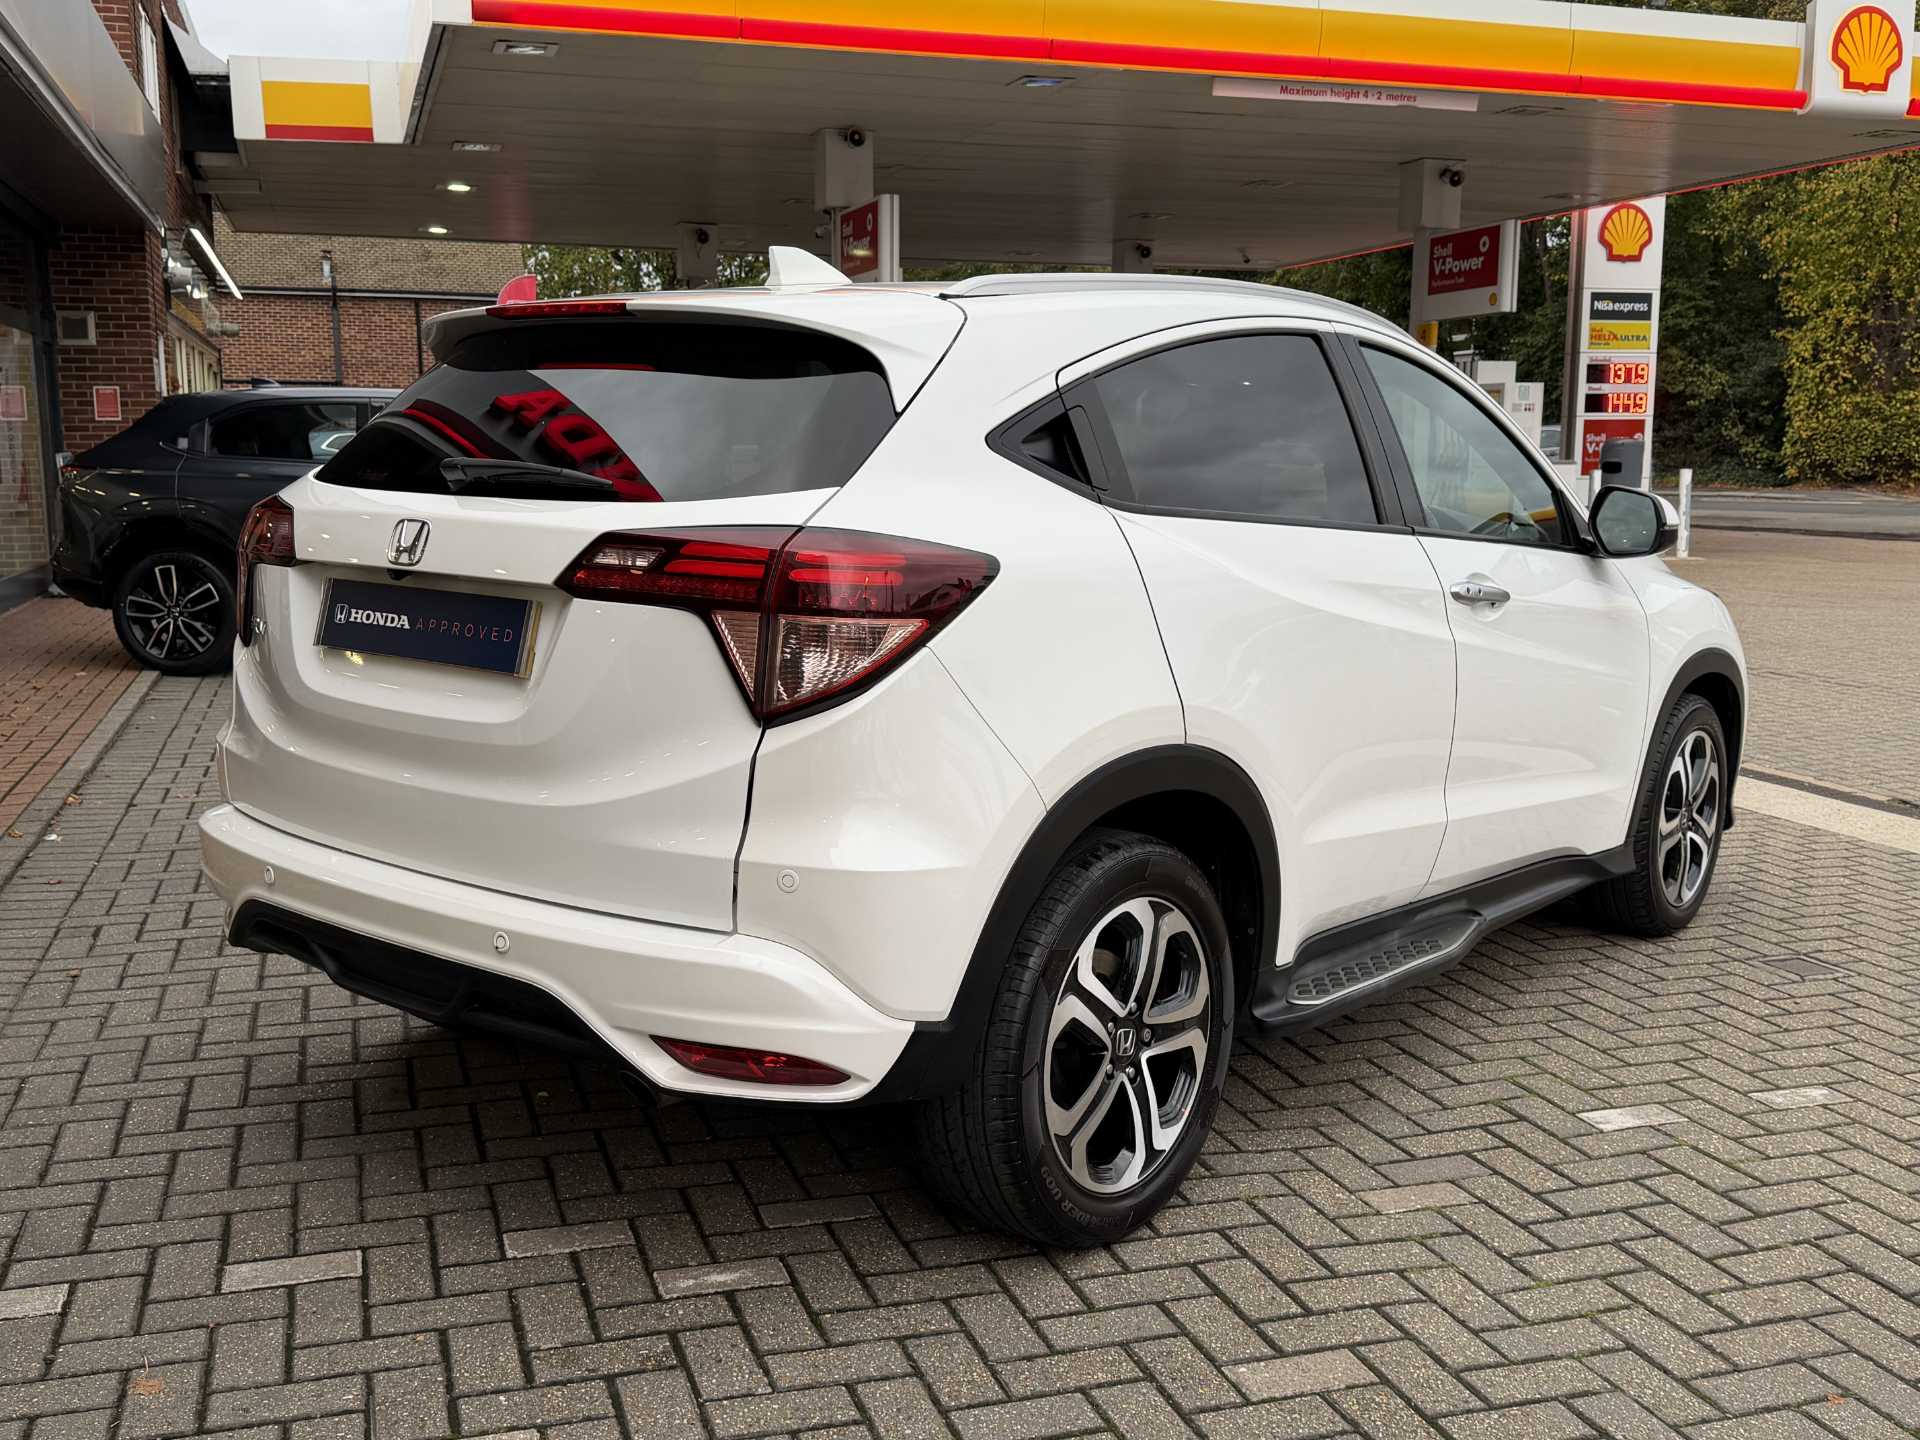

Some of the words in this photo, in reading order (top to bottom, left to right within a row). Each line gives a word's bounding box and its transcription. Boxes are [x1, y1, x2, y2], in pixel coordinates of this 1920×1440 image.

[1280, 85, 1327, 97] Maximum
[1330, 88, 1360, 100] height
[1386, 93, 1417, 102] metres
[1433, 242, 1453, 258] Shell
[1614, 302, 1649, 312] express
[1620, 335, 1648, 343] ULTRA
[349, 608, 410, 629] HONDA
[415, 617, 513, 642] APPROVED
